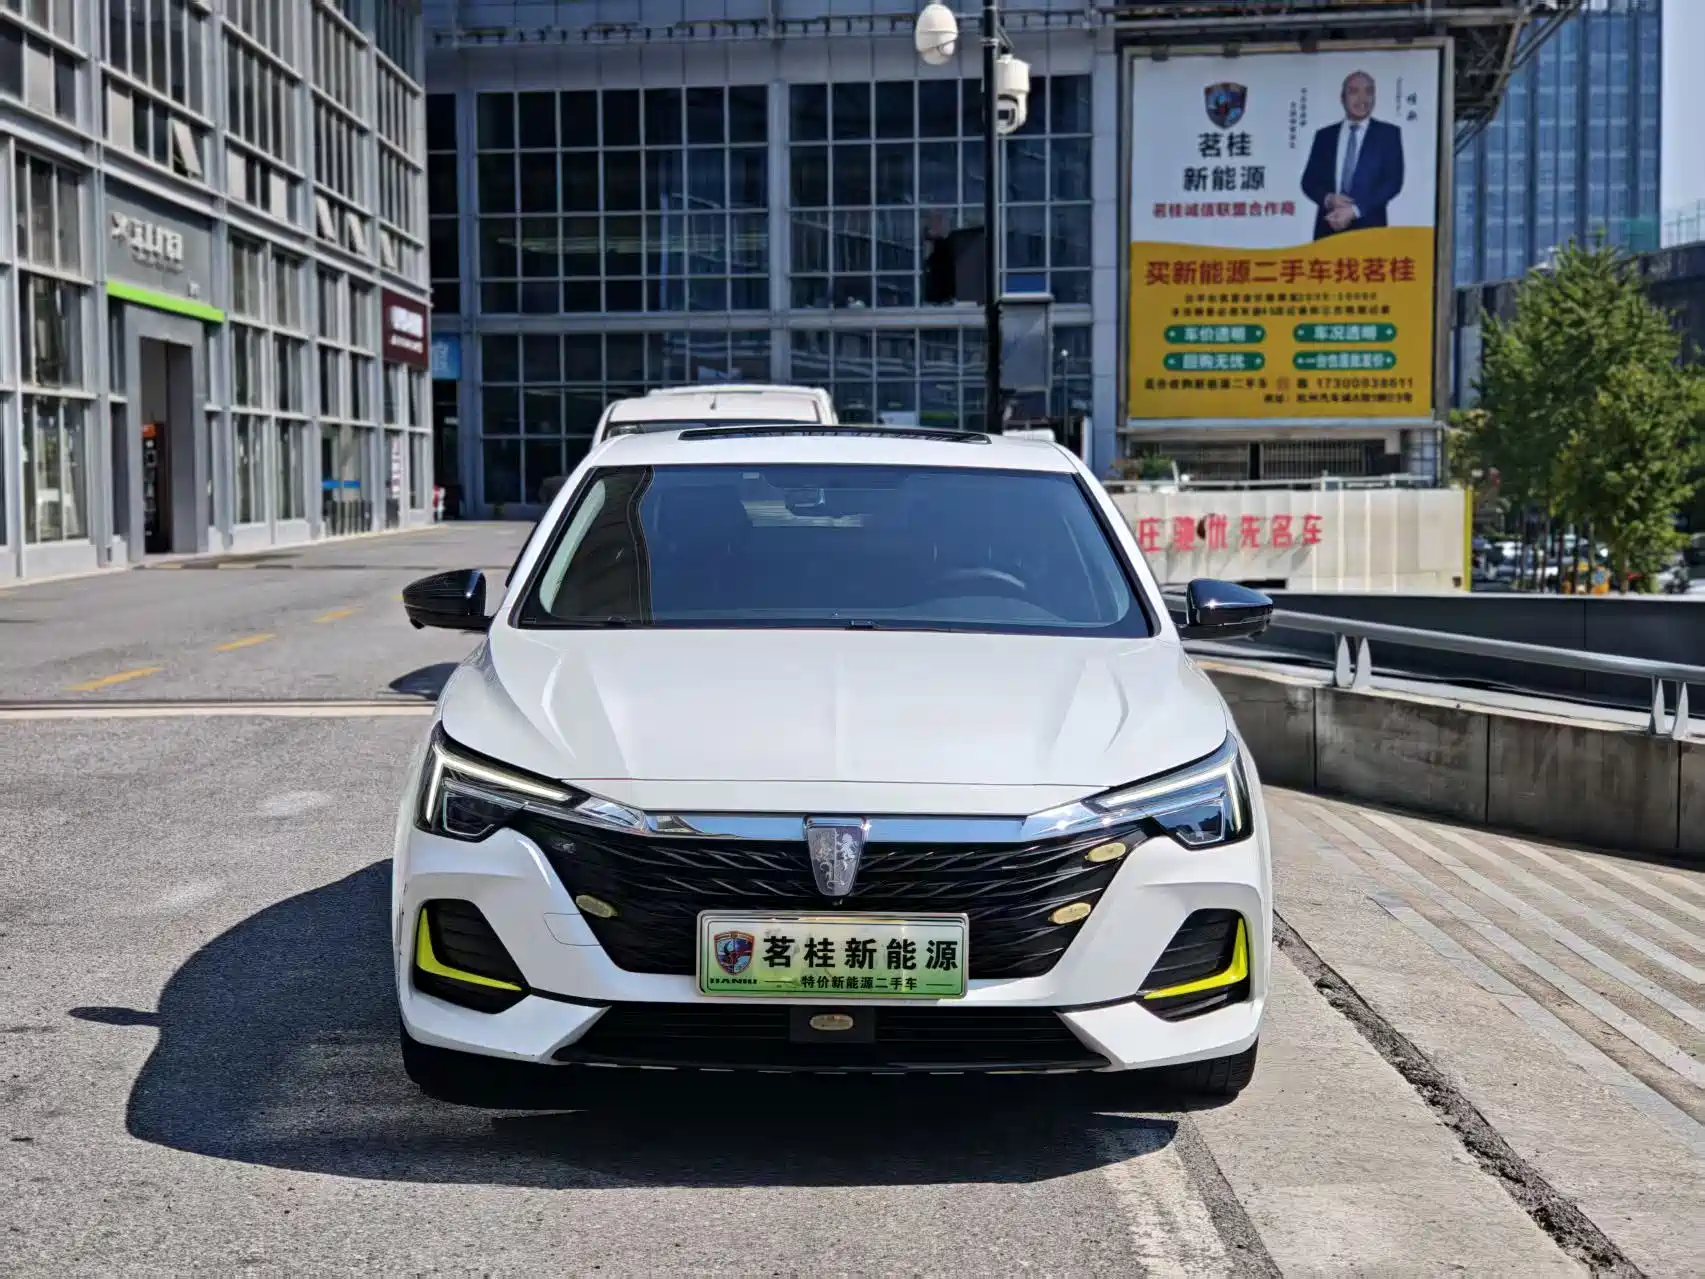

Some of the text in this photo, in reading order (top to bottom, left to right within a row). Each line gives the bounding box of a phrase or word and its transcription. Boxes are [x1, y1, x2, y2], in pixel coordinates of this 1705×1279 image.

[1198, 132, 1252, 158] 茗桂
[1183, 165, 1266, 192] 新能源
[1145, 255, 1416, 285] 买新能源二手车找茗桂
[763, 935, 959, 971] 茗桂新能源
[801, 975, 917, 991] 特价新能源二手车
